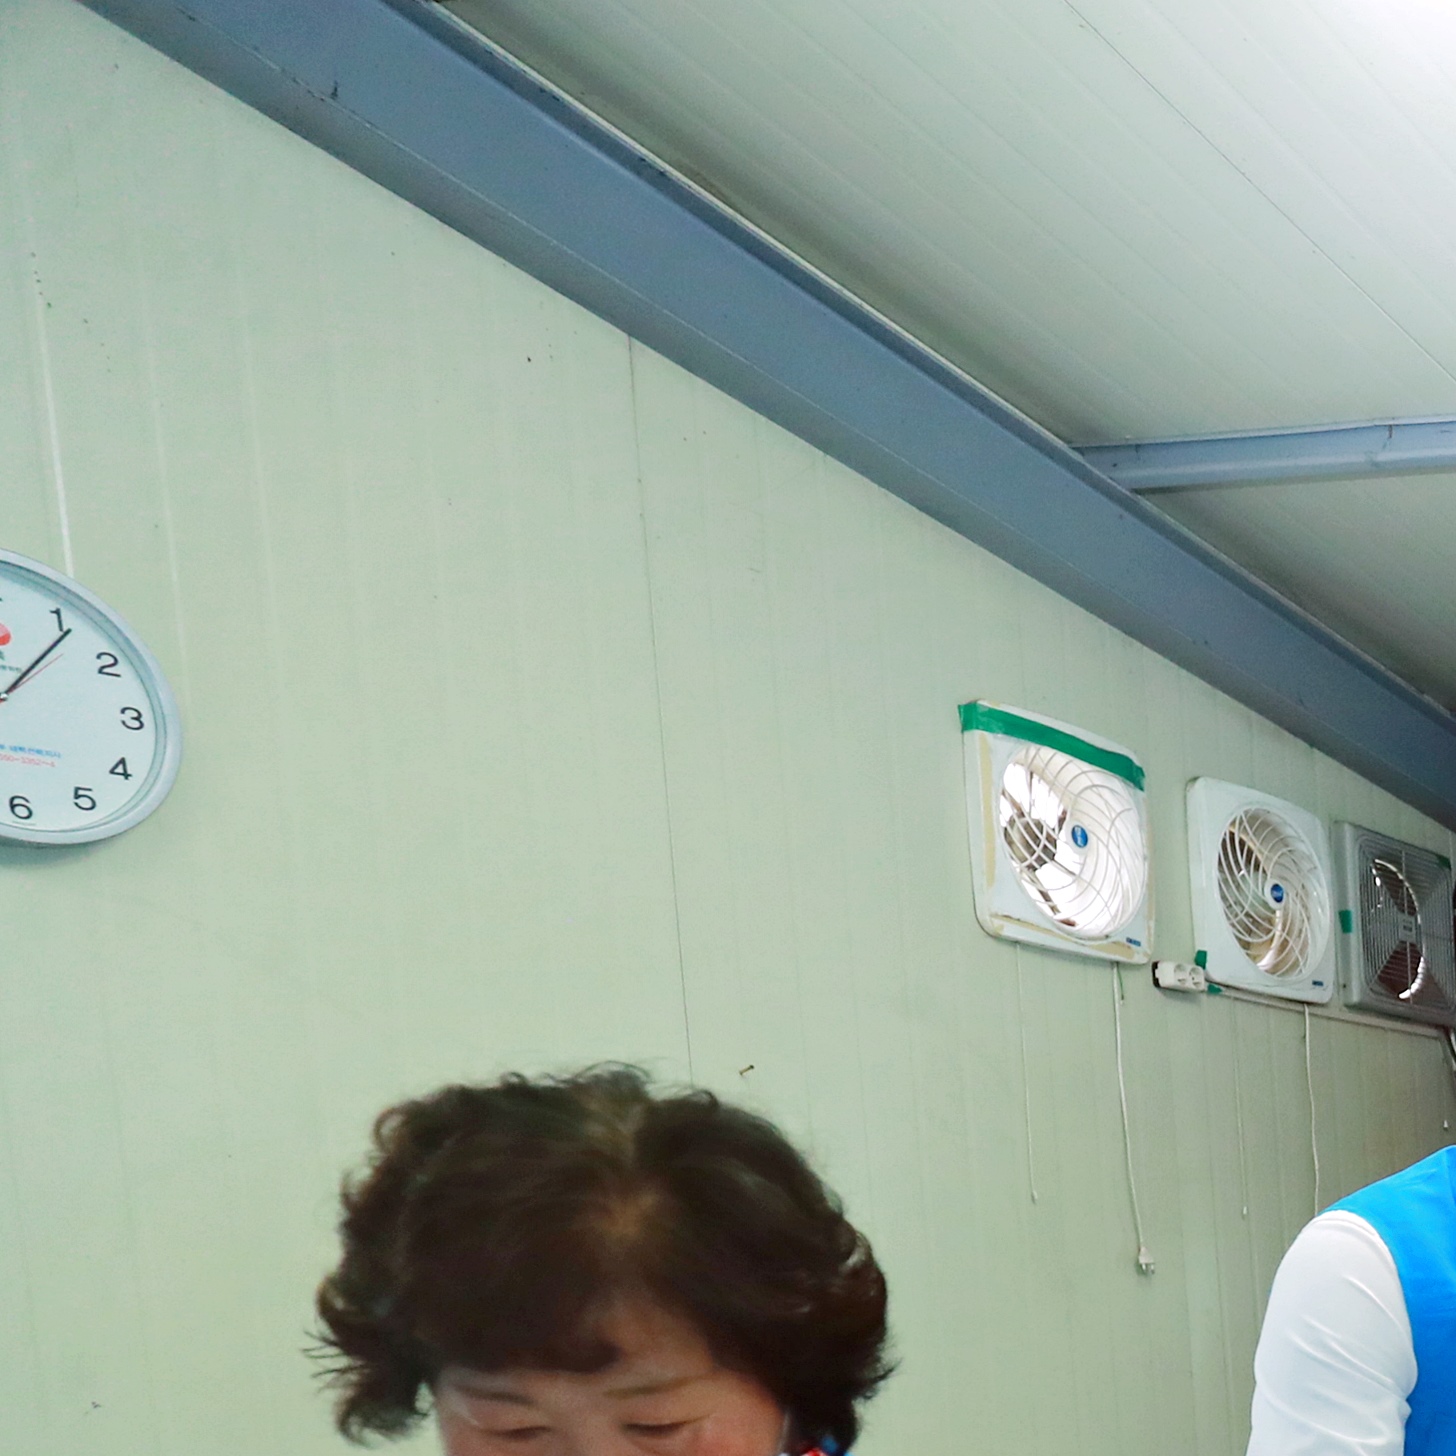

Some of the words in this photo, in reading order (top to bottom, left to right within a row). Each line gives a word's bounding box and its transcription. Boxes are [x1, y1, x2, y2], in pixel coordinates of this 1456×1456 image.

[49, 607, 64, 632] 1
[96, 651, 122, 678] 2
[119, 706, 145, 731] 3
[108, 757, 133, 781] 4
[8, 795, 33, 820] 6
[73, 786, 97, 811] 5
